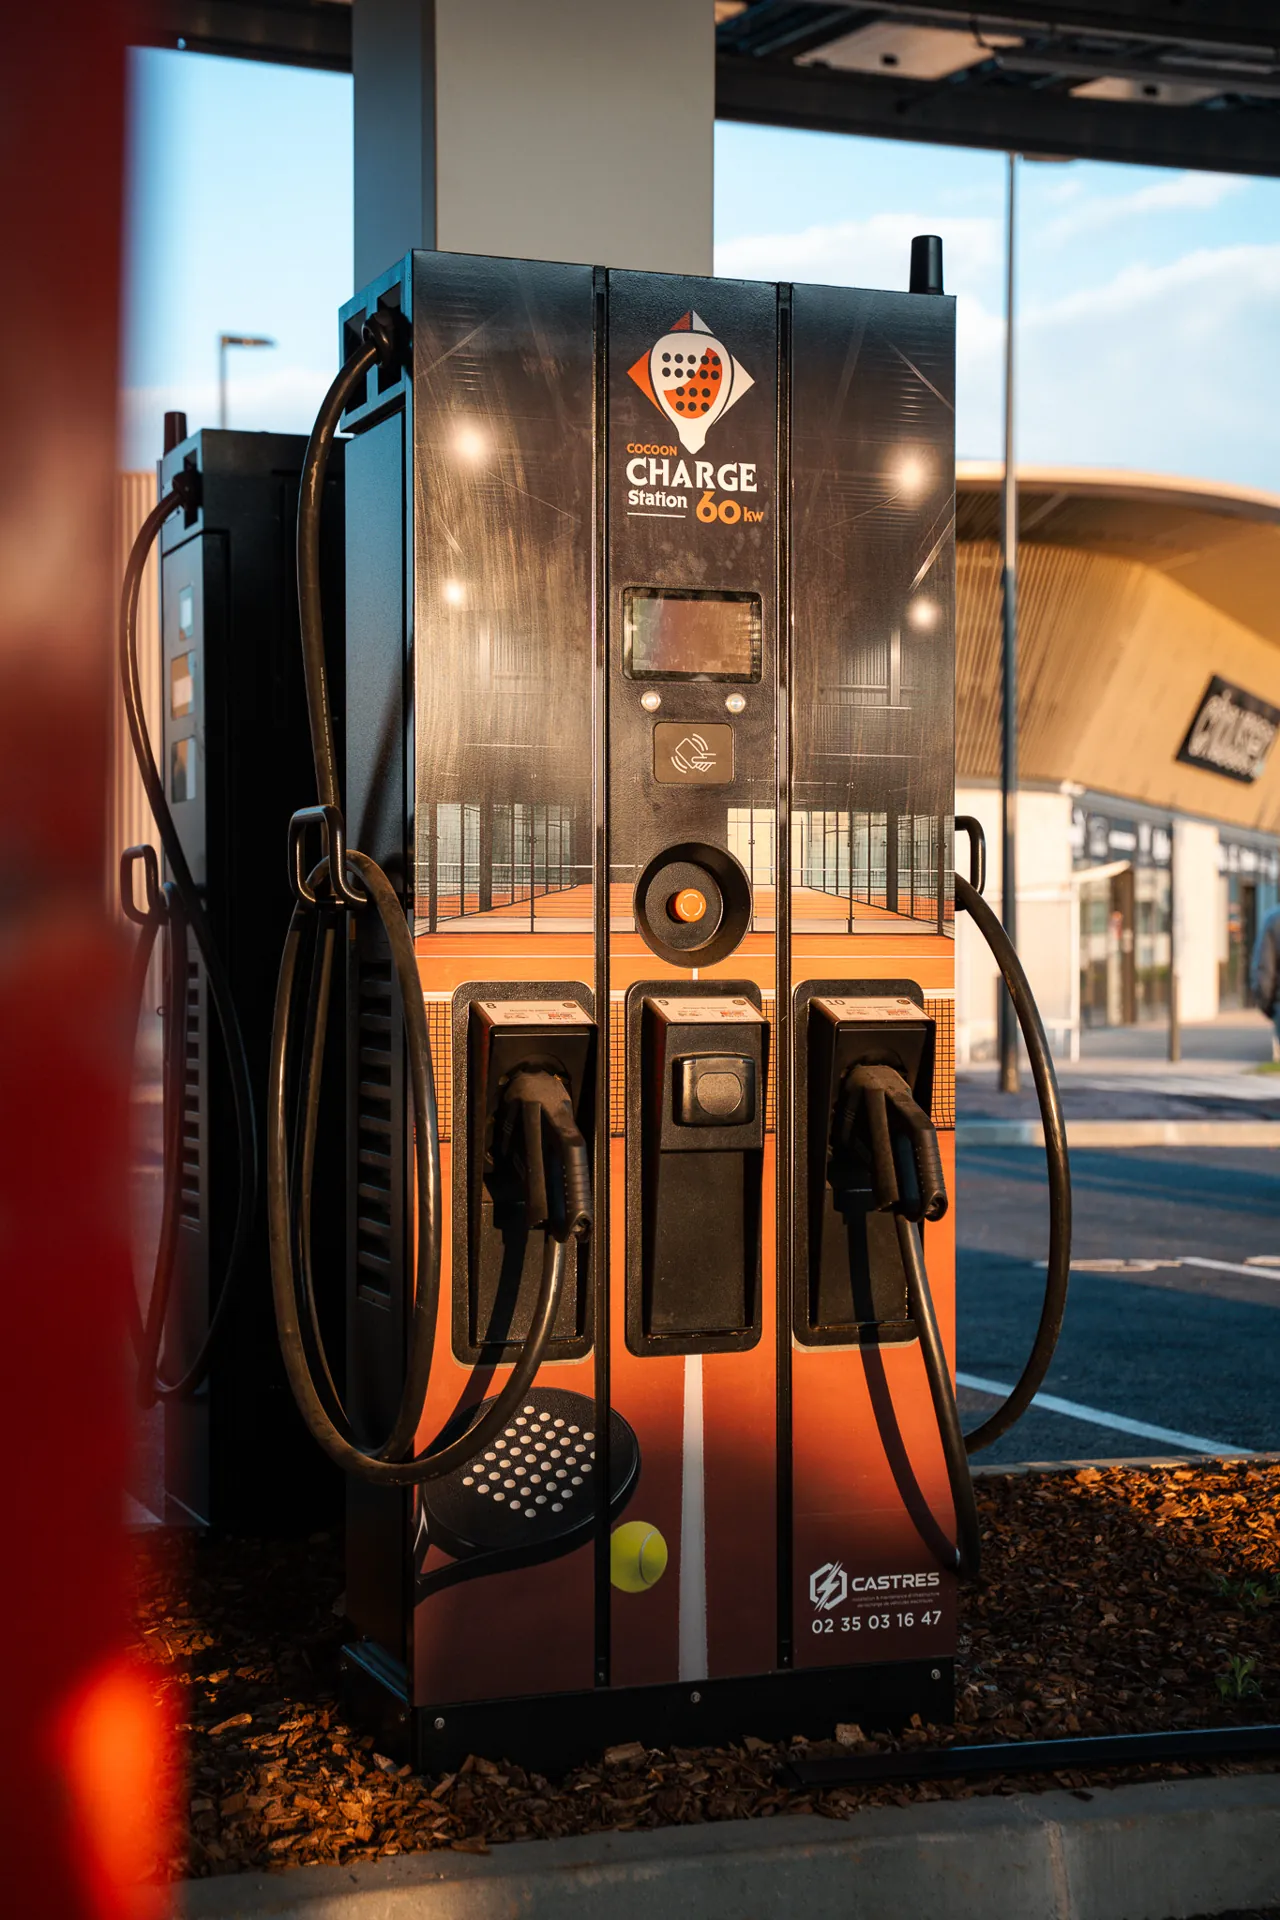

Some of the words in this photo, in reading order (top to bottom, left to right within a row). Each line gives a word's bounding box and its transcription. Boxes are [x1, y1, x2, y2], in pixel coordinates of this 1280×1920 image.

[626, 443, 678, 456] COCOON
[626, 457, 758, 492] CHARGE
[628, 489, 688, 509] Station
[696, 491, 742, 525] 60
[851, 1572, 940, 1592] CASTRES
[811, 1619, 834, 1634] 02
[841, 1616, 861, 1632] 35
[868, 1614, 890, 1630] 03
[897, 1612, 914, 1627] 16
[921, 1610, 942, 1625] 47
